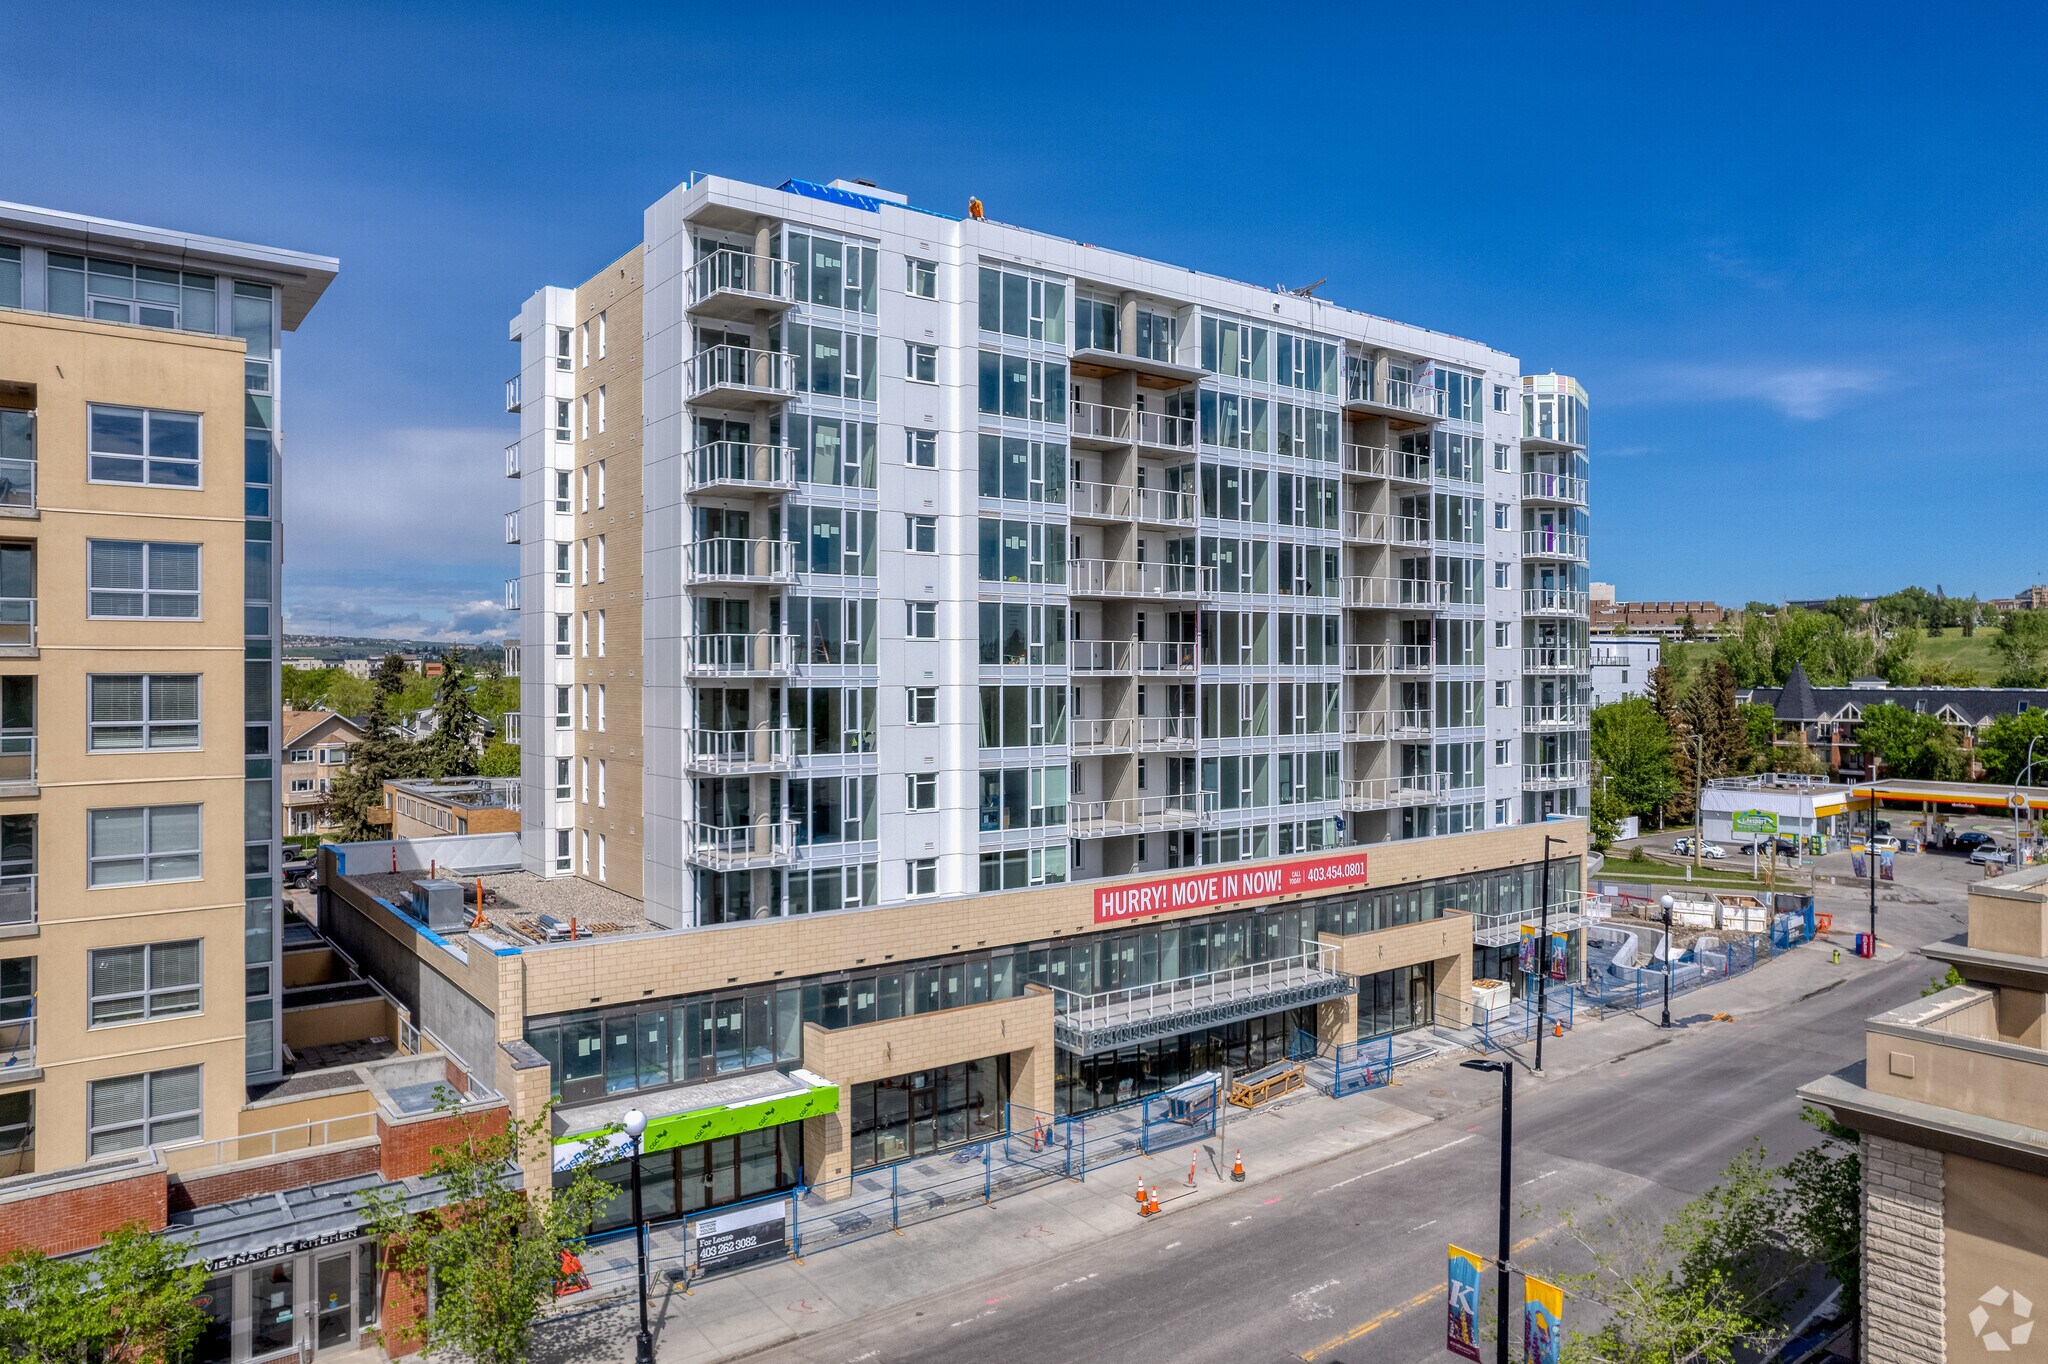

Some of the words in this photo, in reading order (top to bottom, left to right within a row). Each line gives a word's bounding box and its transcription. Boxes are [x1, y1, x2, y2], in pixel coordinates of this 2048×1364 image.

[1307, 862, 1365, 882] 403.454.0801
[1289, 877, 1302, 885] TODAY
[1101, 885, 1167, 917] HURRY!
[1172, 878, 1218, 907] MOVE
[1222, 875, 1238, 899] IN
[1242, 869, 1282, 896] NOW!
[758, 1116, 768, 1126] CGC
[694, 1128, 705, 1140] CGC
[649, 1138, 660, 1150] CGC
[300, 1231, 357, 1250] KITCHEN
[700, 1239, 712, 1248] For
[712, 1234, 734, 1244] Lease
[700, 1247, 717, 1259] 403
[717, 1241, 735, 1255] 262
[735, 1235, 757, 1250] 3082
[1448, 1279, 1475, 1316] K
